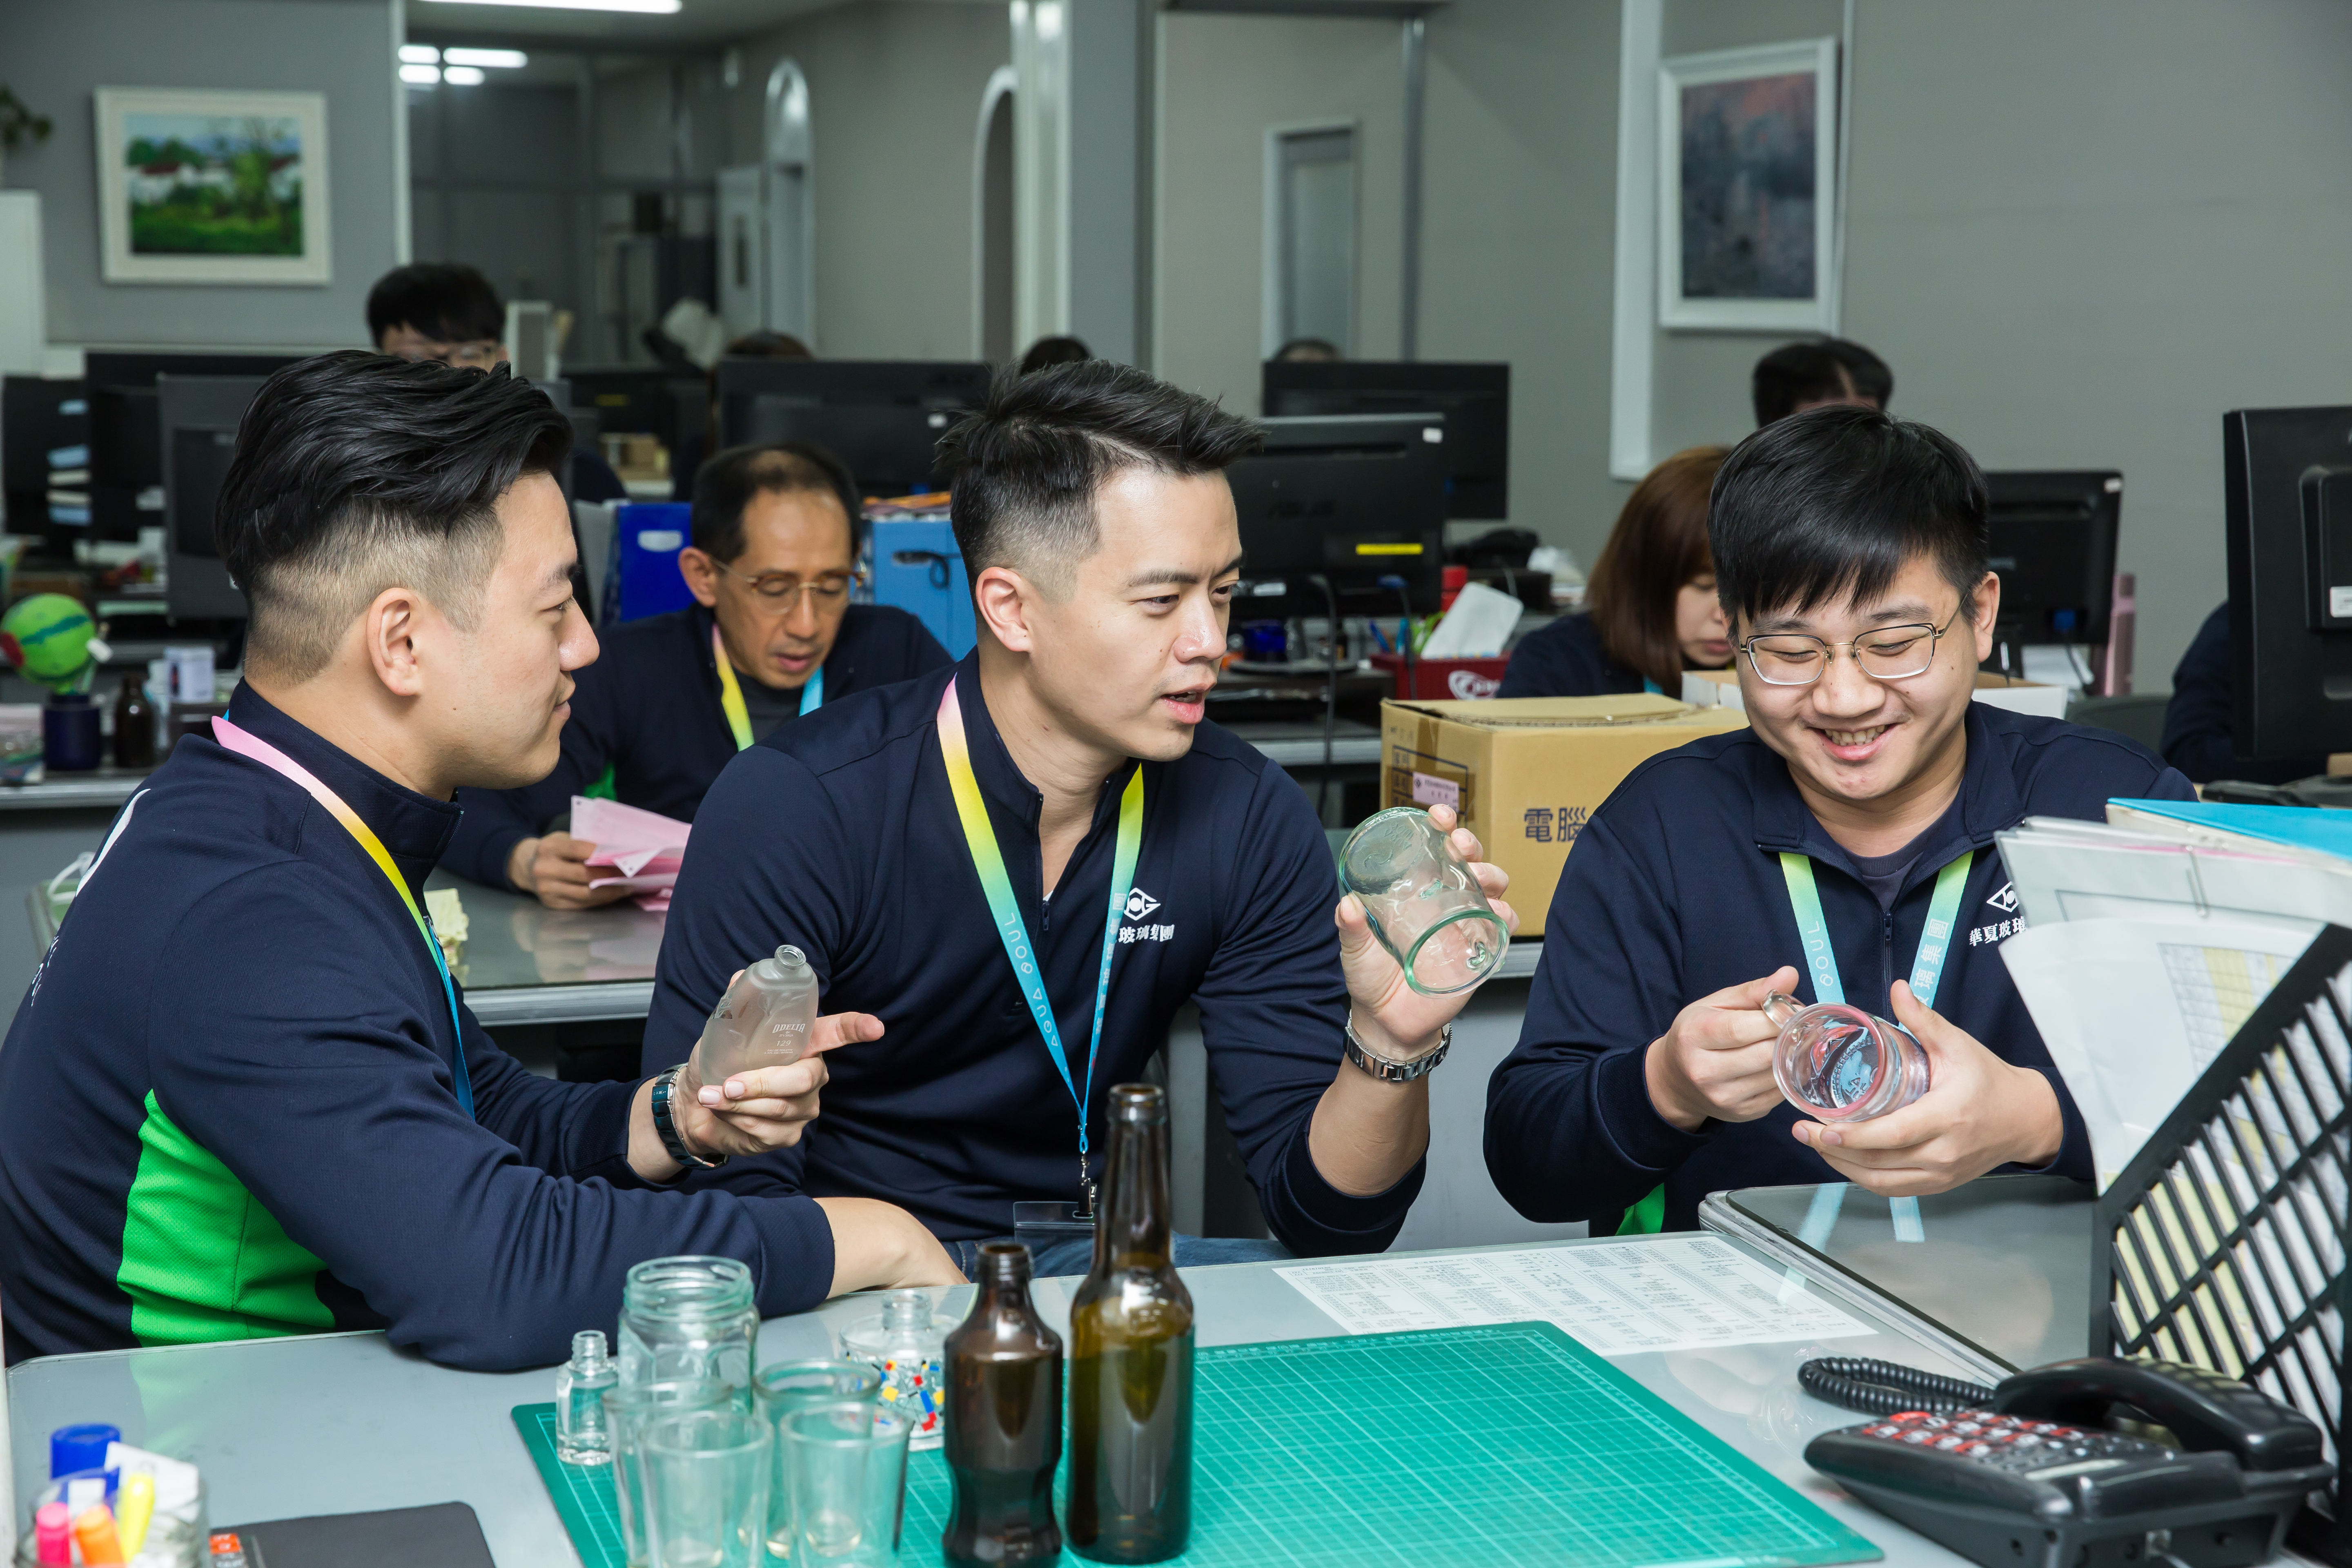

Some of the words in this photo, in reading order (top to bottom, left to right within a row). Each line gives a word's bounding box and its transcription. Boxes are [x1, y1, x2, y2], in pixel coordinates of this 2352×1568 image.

[1523, 807, 1586, 842] 電腦
[1115, 924, 1175, 944] 玻璃集團
[772, 1023, 806, 1033] ODELIA
